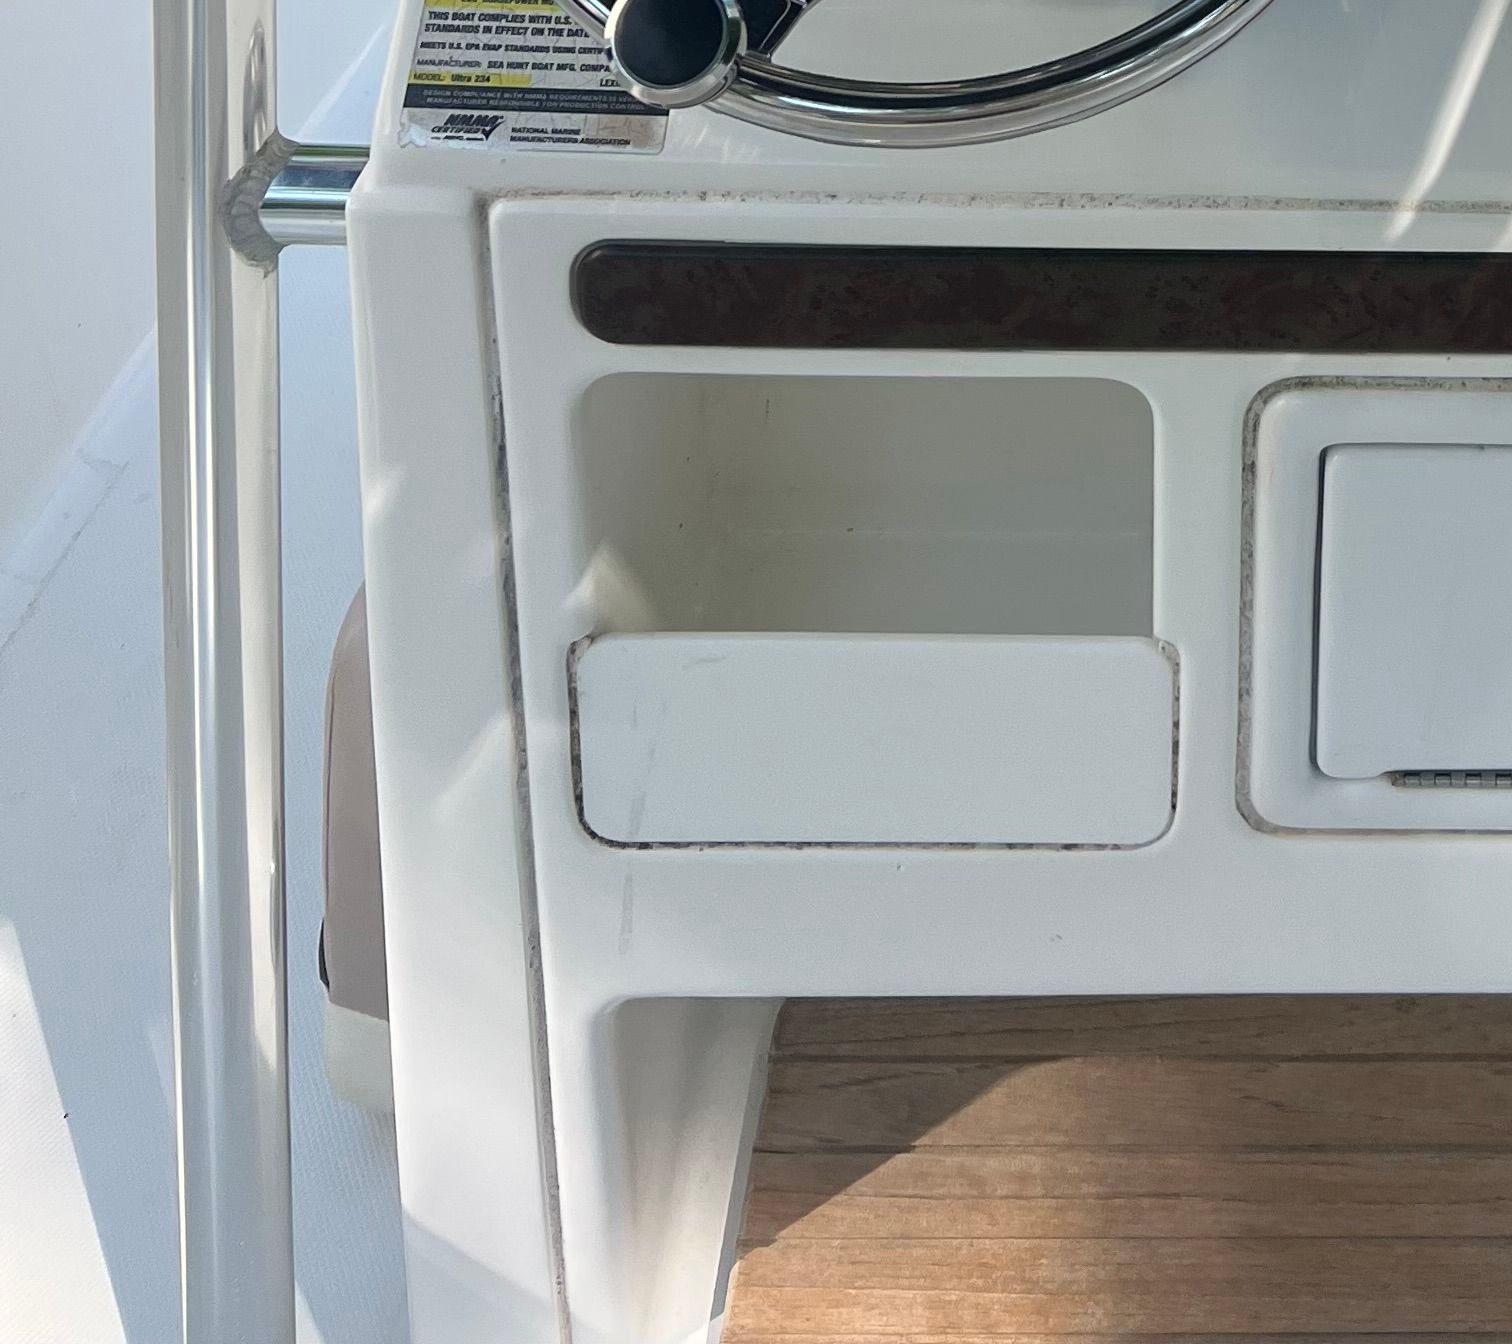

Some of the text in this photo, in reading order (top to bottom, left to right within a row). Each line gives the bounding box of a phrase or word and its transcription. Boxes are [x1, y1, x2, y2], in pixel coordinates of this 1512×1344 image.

[428, 11, 449, 21] THIS
[451, 12, 476, 22] BOAT
[478, 13, 526, 23] COMPLIES
[528, 15, 553, 25] WITH
[424, 23, 480, 34] STANDARDS
[483, 25, 492, 34] IN
[495, 25, 528, 36] EFFECT
[531, 27, 545, 36] ON
[547, 27, 564, 37] THE
[504, 43, 550, 53] STANDARDS
[487, 60, 504, 69] SEA
[506, 61, 529, 70] HUNT
[531, 62, 554, 71] BOAT
[451, 74, 472, 83] Ultra
[474, 75, 491, 83] 234
